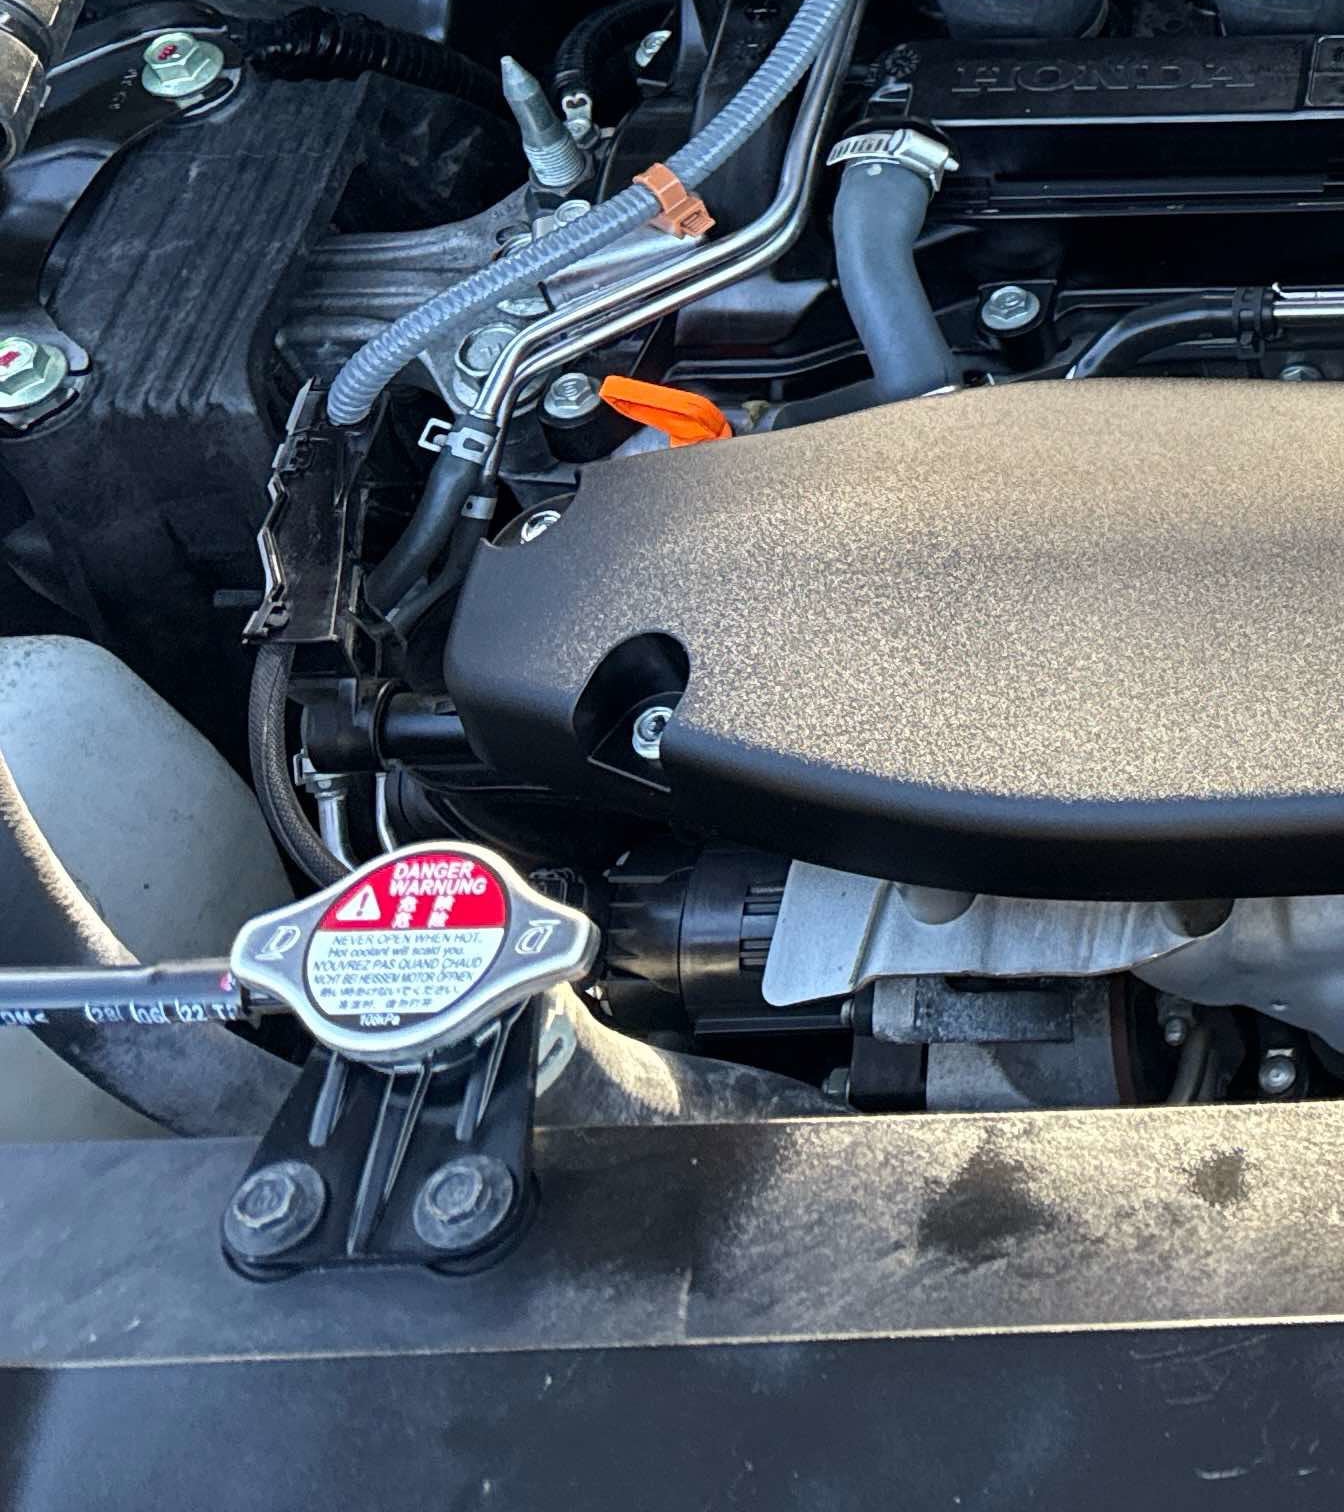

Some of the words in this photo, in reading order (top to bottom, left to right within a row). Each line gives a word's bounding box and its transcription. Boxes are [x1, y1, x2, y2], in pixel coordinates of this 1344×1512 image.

[950, 61, 1256, 92] HONDA
[394, 861, 475, 880] DANGER
[389, 877, 488, 897] WARNUNG
[332, 934, 374, 945] NEVER
[377, 933, 410, 944] OPEN
[414, 932, 451, 943] WHEN
[454, 931, 483, 944] HOT.
[328, 947, 349, 958] Hot
[350, 947, 390, 958] coolant
[392, 946, 409, 956] will
[412, 946, 440, 956] scald
[373, 959, 396, 970] PAS
[398, 958, 440, 970] QUAND
[442, 957, 483, 969] CHAUD
[313, 974, 341, 985] NICHT
[342, 974, 358, 984] BEI
[401, 972, 435, 983] MOTOR
